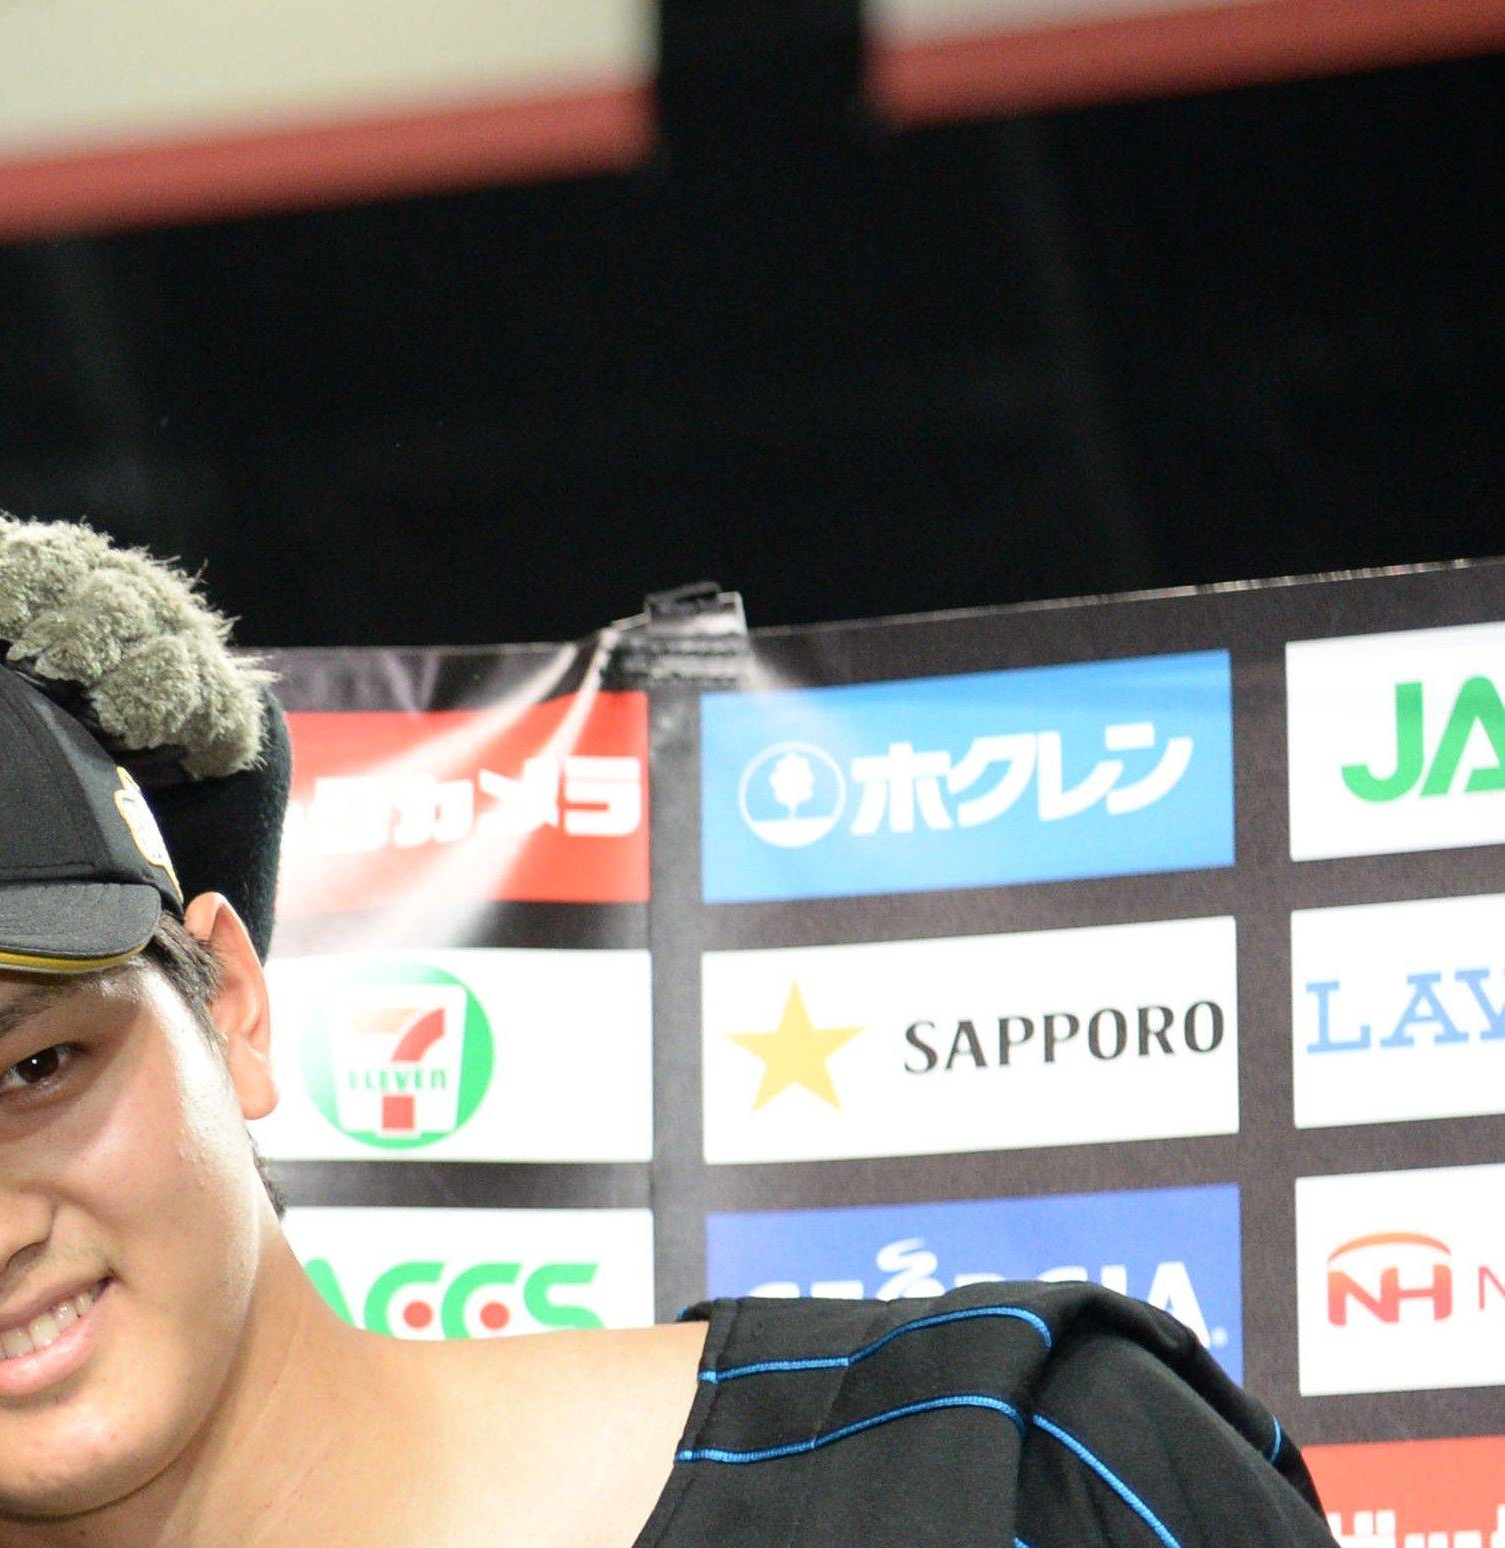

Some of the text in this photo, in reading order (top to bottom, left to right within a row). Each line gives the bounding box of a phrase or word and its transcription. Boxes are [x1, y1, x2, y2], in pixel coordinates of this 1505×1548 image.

[850, 722, 1193, 836] ホクレン
[903, 1000, 1225, 1075] SAPPORO
